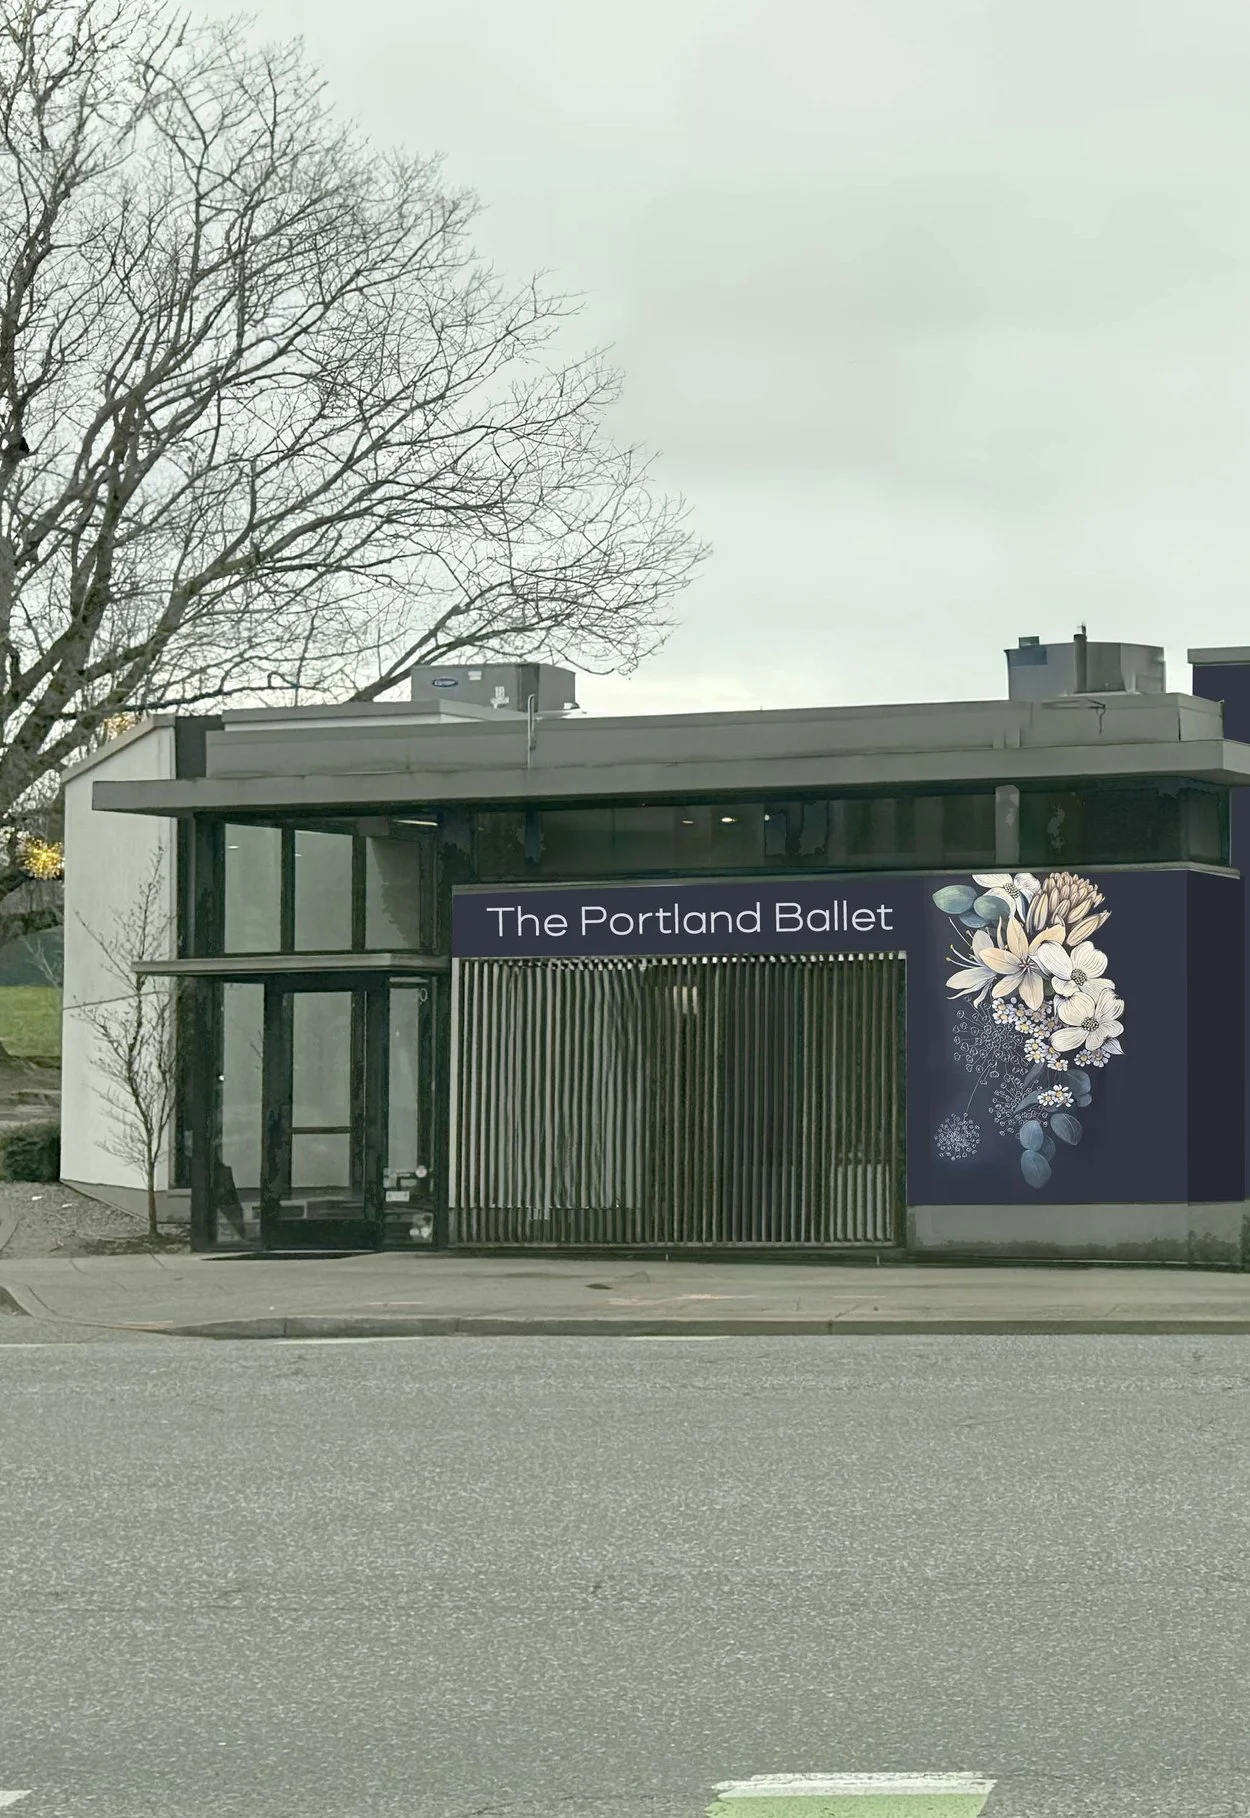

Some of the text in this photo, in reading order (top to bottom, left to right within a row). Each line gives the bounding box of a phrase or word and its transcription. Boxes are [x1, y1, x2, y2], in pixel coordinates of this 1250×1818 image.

[486, 900, 894, 937] The Portland Ballet
